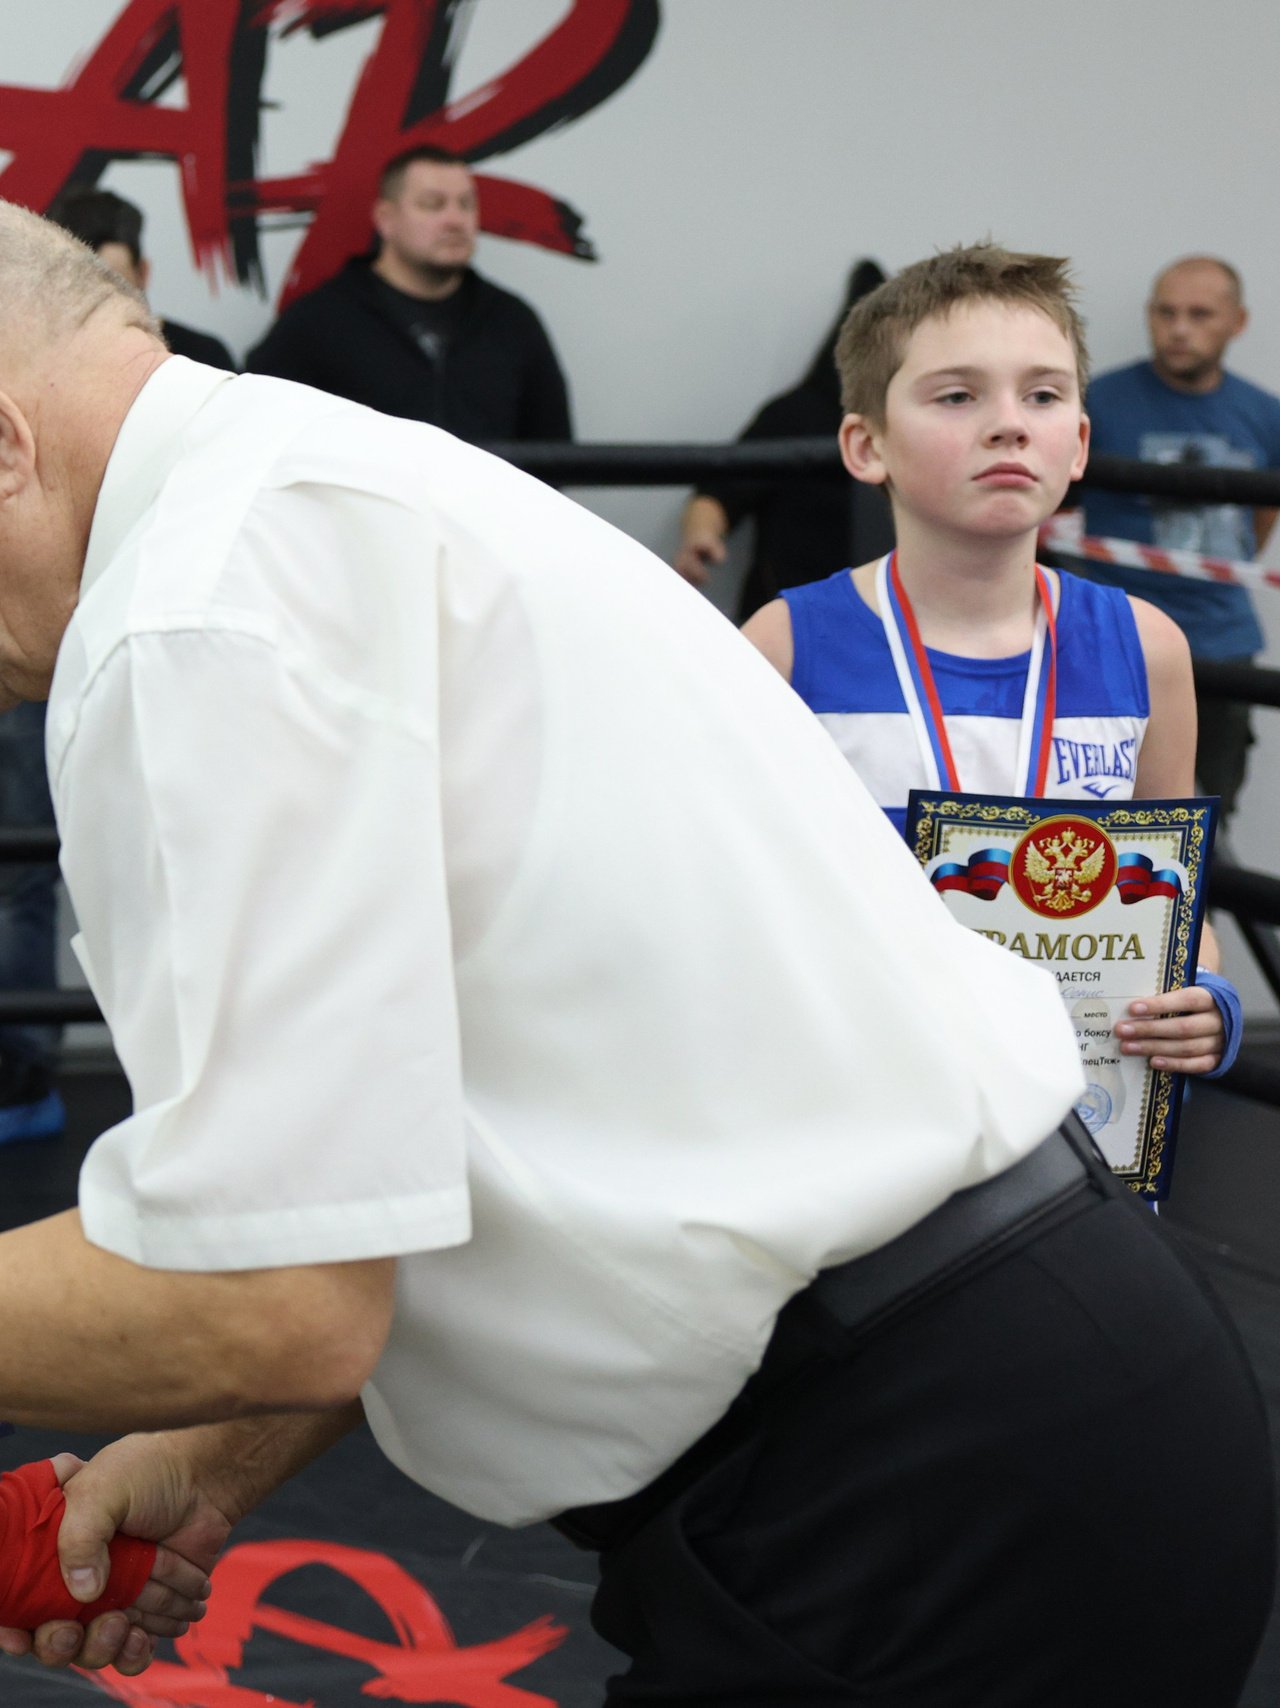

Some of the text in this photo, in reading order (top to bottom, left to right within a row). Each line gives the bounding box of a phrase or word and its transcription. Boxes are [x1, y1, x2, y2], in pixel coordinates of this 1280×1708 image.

[971, 929, 1145, 961] РАМОТА
[1054, 971, 1101, 983] ДАЕТСЯ
[1084, 1011, 1108, 1019] место
[1084, 1028, 1112, 1039] боксу
